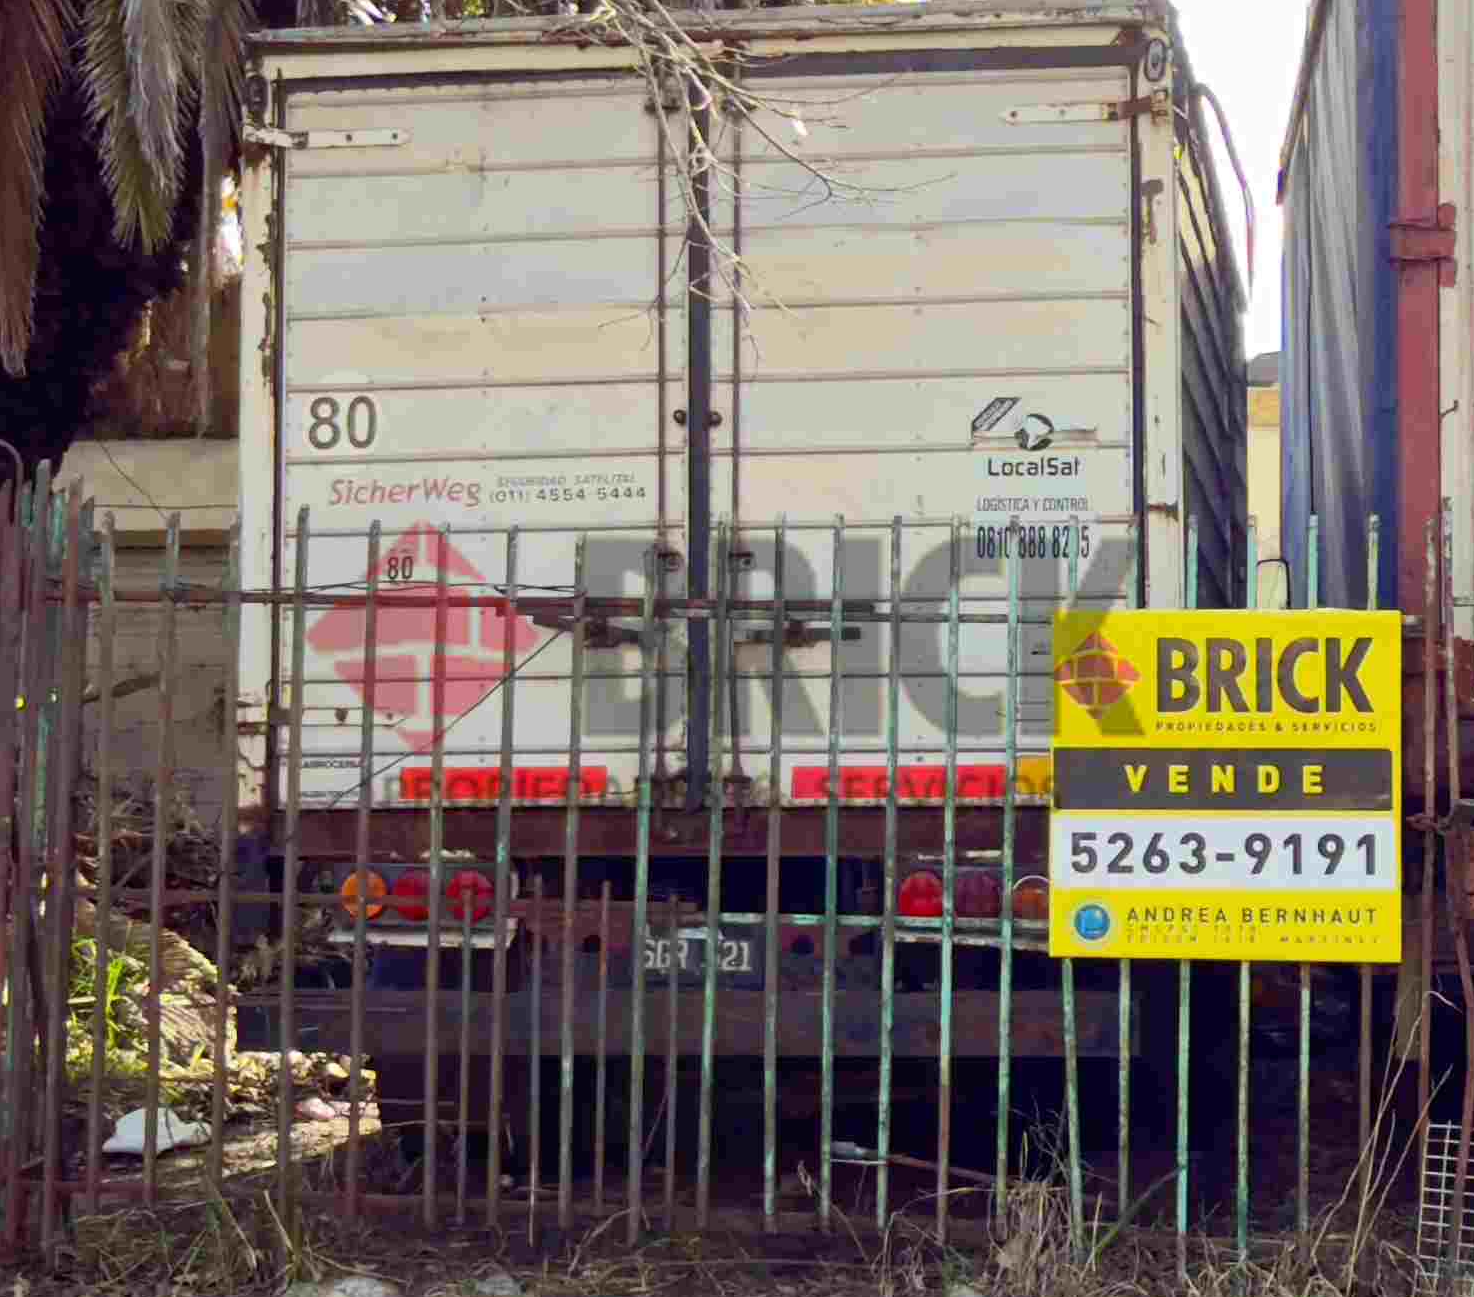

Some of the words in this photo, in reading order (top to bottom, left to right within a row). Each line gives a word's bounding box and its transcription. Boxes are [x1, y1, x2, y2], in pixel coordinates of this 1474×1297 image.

[308, 395, 377, 449] 80
[987, 456, 1080, 476] LocalSat
[328, 477, 481, 507] SicherWeg
[536, 487, 586, 501] 4554
[597, 486, 646, 500] 5444
[1052, 525, 1090, 559] 825
[388, 555, 414, 580] 80
[1156, 637, 1374, 713] BRICK
[1155, 721, 1266, 732] PROPIEDADES
[1292, 721, 1377, 732] SERVICIOS
[1125, 765, 1324, 794] VENDE
[1071, 832, 1376, 876] 5263-9191
[1127, 907, 1227, 923] ANDREA
[1242, 908, 1377, 924] BERNHAUT
